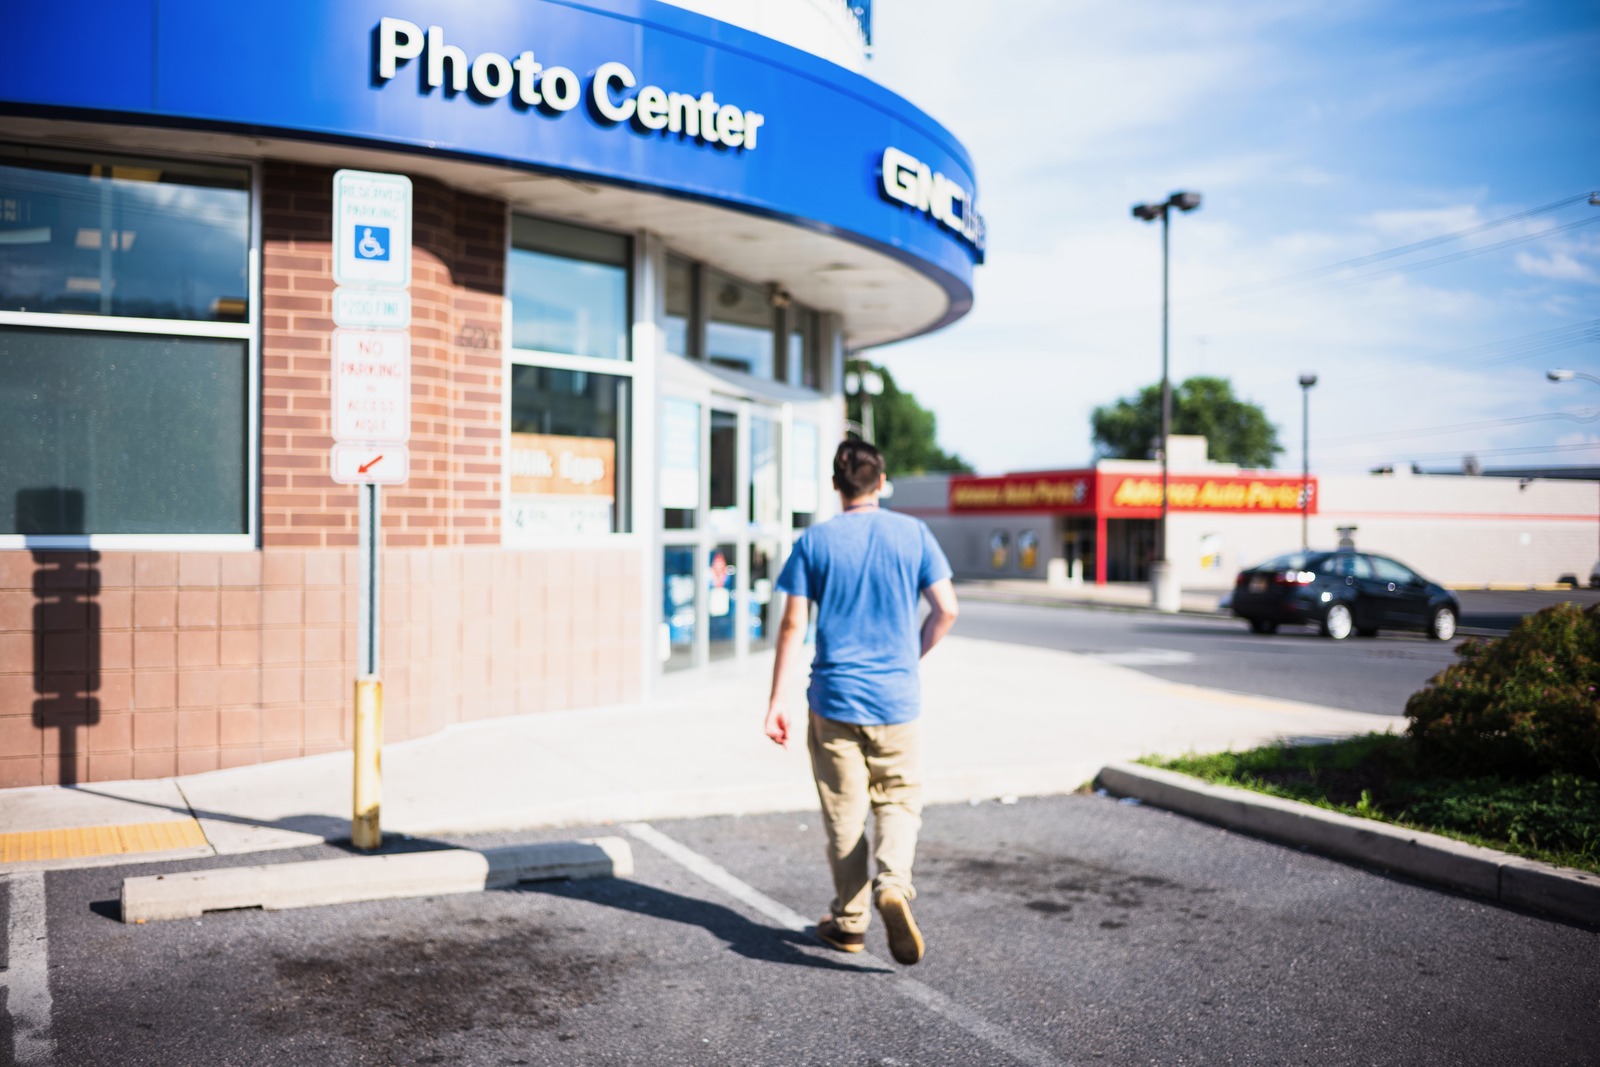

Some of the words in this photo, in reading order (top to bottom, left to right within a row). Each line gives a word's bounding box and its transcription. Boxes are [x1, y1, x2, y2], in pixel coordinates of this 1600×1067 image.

[378, 16, 581, 112] Photo
[592, 61, 765, 150] Center
[881, 145, 968, 236] GNC
[347, 203, 400, 219] PARKING
[358, 339, 384, 357] NO
[341, 361, 402, 379] PARKING
[1199, 479, 1247, 508] Auto
[1247, 480, 1301, 509] Parts
